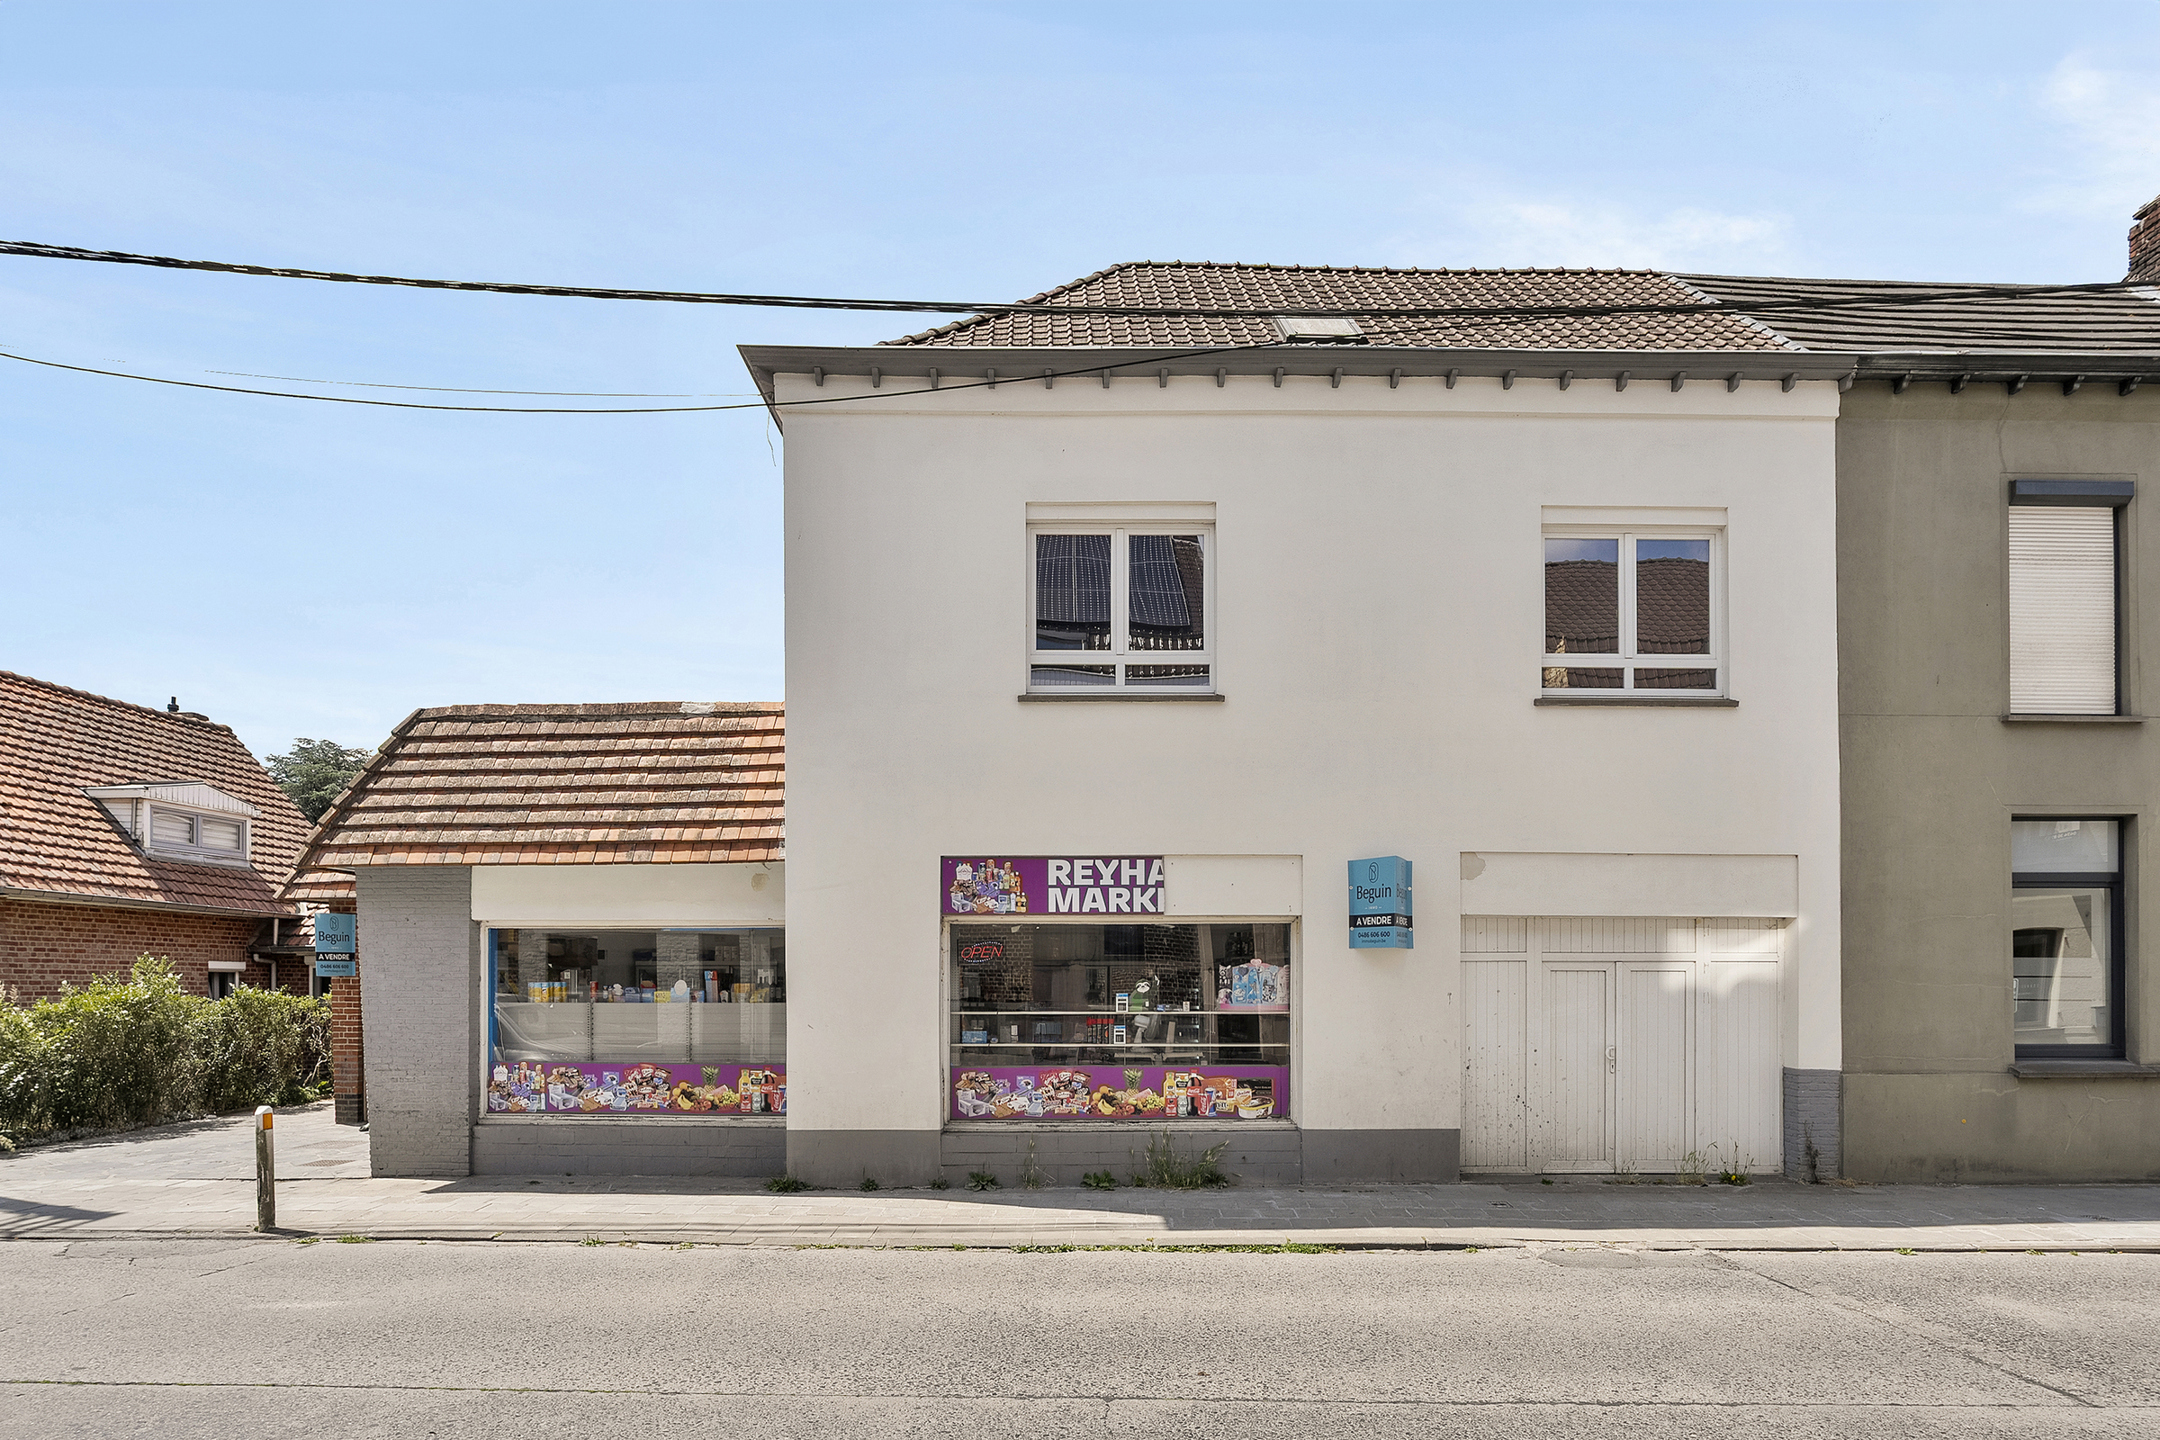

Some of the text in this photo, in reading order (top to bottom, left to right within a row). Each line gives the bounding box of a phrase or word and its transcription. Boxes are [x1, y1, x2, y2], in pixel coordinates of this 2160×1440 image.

[1047, 859, 1164, 886] REYHA
[1356, 883, 1392, 903] Beguin
[1362, 915, 1392, 926] VENDRE
[318, 931, 350, 945] Beguin
[324, 953, 350, 961] VENDRE
[961, 945, 1004, 959] OPEN
